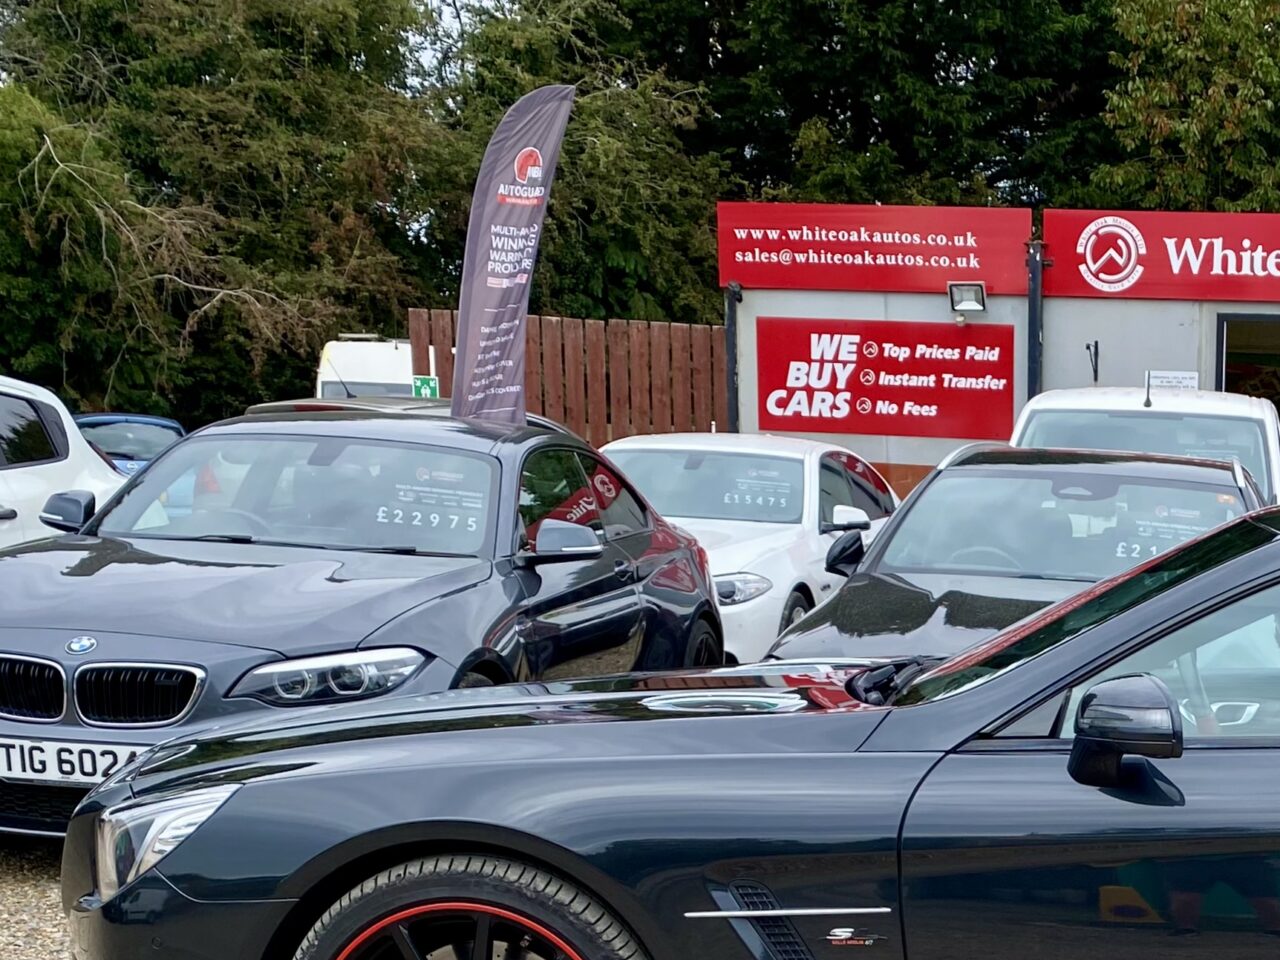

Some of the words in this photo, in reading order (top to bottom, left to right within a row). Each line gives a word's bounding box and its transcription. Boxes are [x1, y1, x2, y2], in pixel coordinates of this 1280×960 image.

[497, 183, 545, 198] AUTOGUAD
[734, 225, 978, 247] www.whiteoakautos.co.uk
[735, 248, 981, 270] sales@whiteoakautos.co.uk
[809, 332, 862, 362] WE
[882, 341, 912, 363] Top
[915, 344, 961, 361] Prices
[964, 345, 1000, 362] Paid
[785, 360, 857, 389] BUY
[878, 370, 936, 388] Instant
[942, 372, 1007, 391] Transfer
[765, 389, 853, 420] CARS
[875, 399, 899, 416] No
[902, 400, 939, 417] Fees
[724, 492, 787, 508] £15475
[376, 506, 478, 532] £22975
